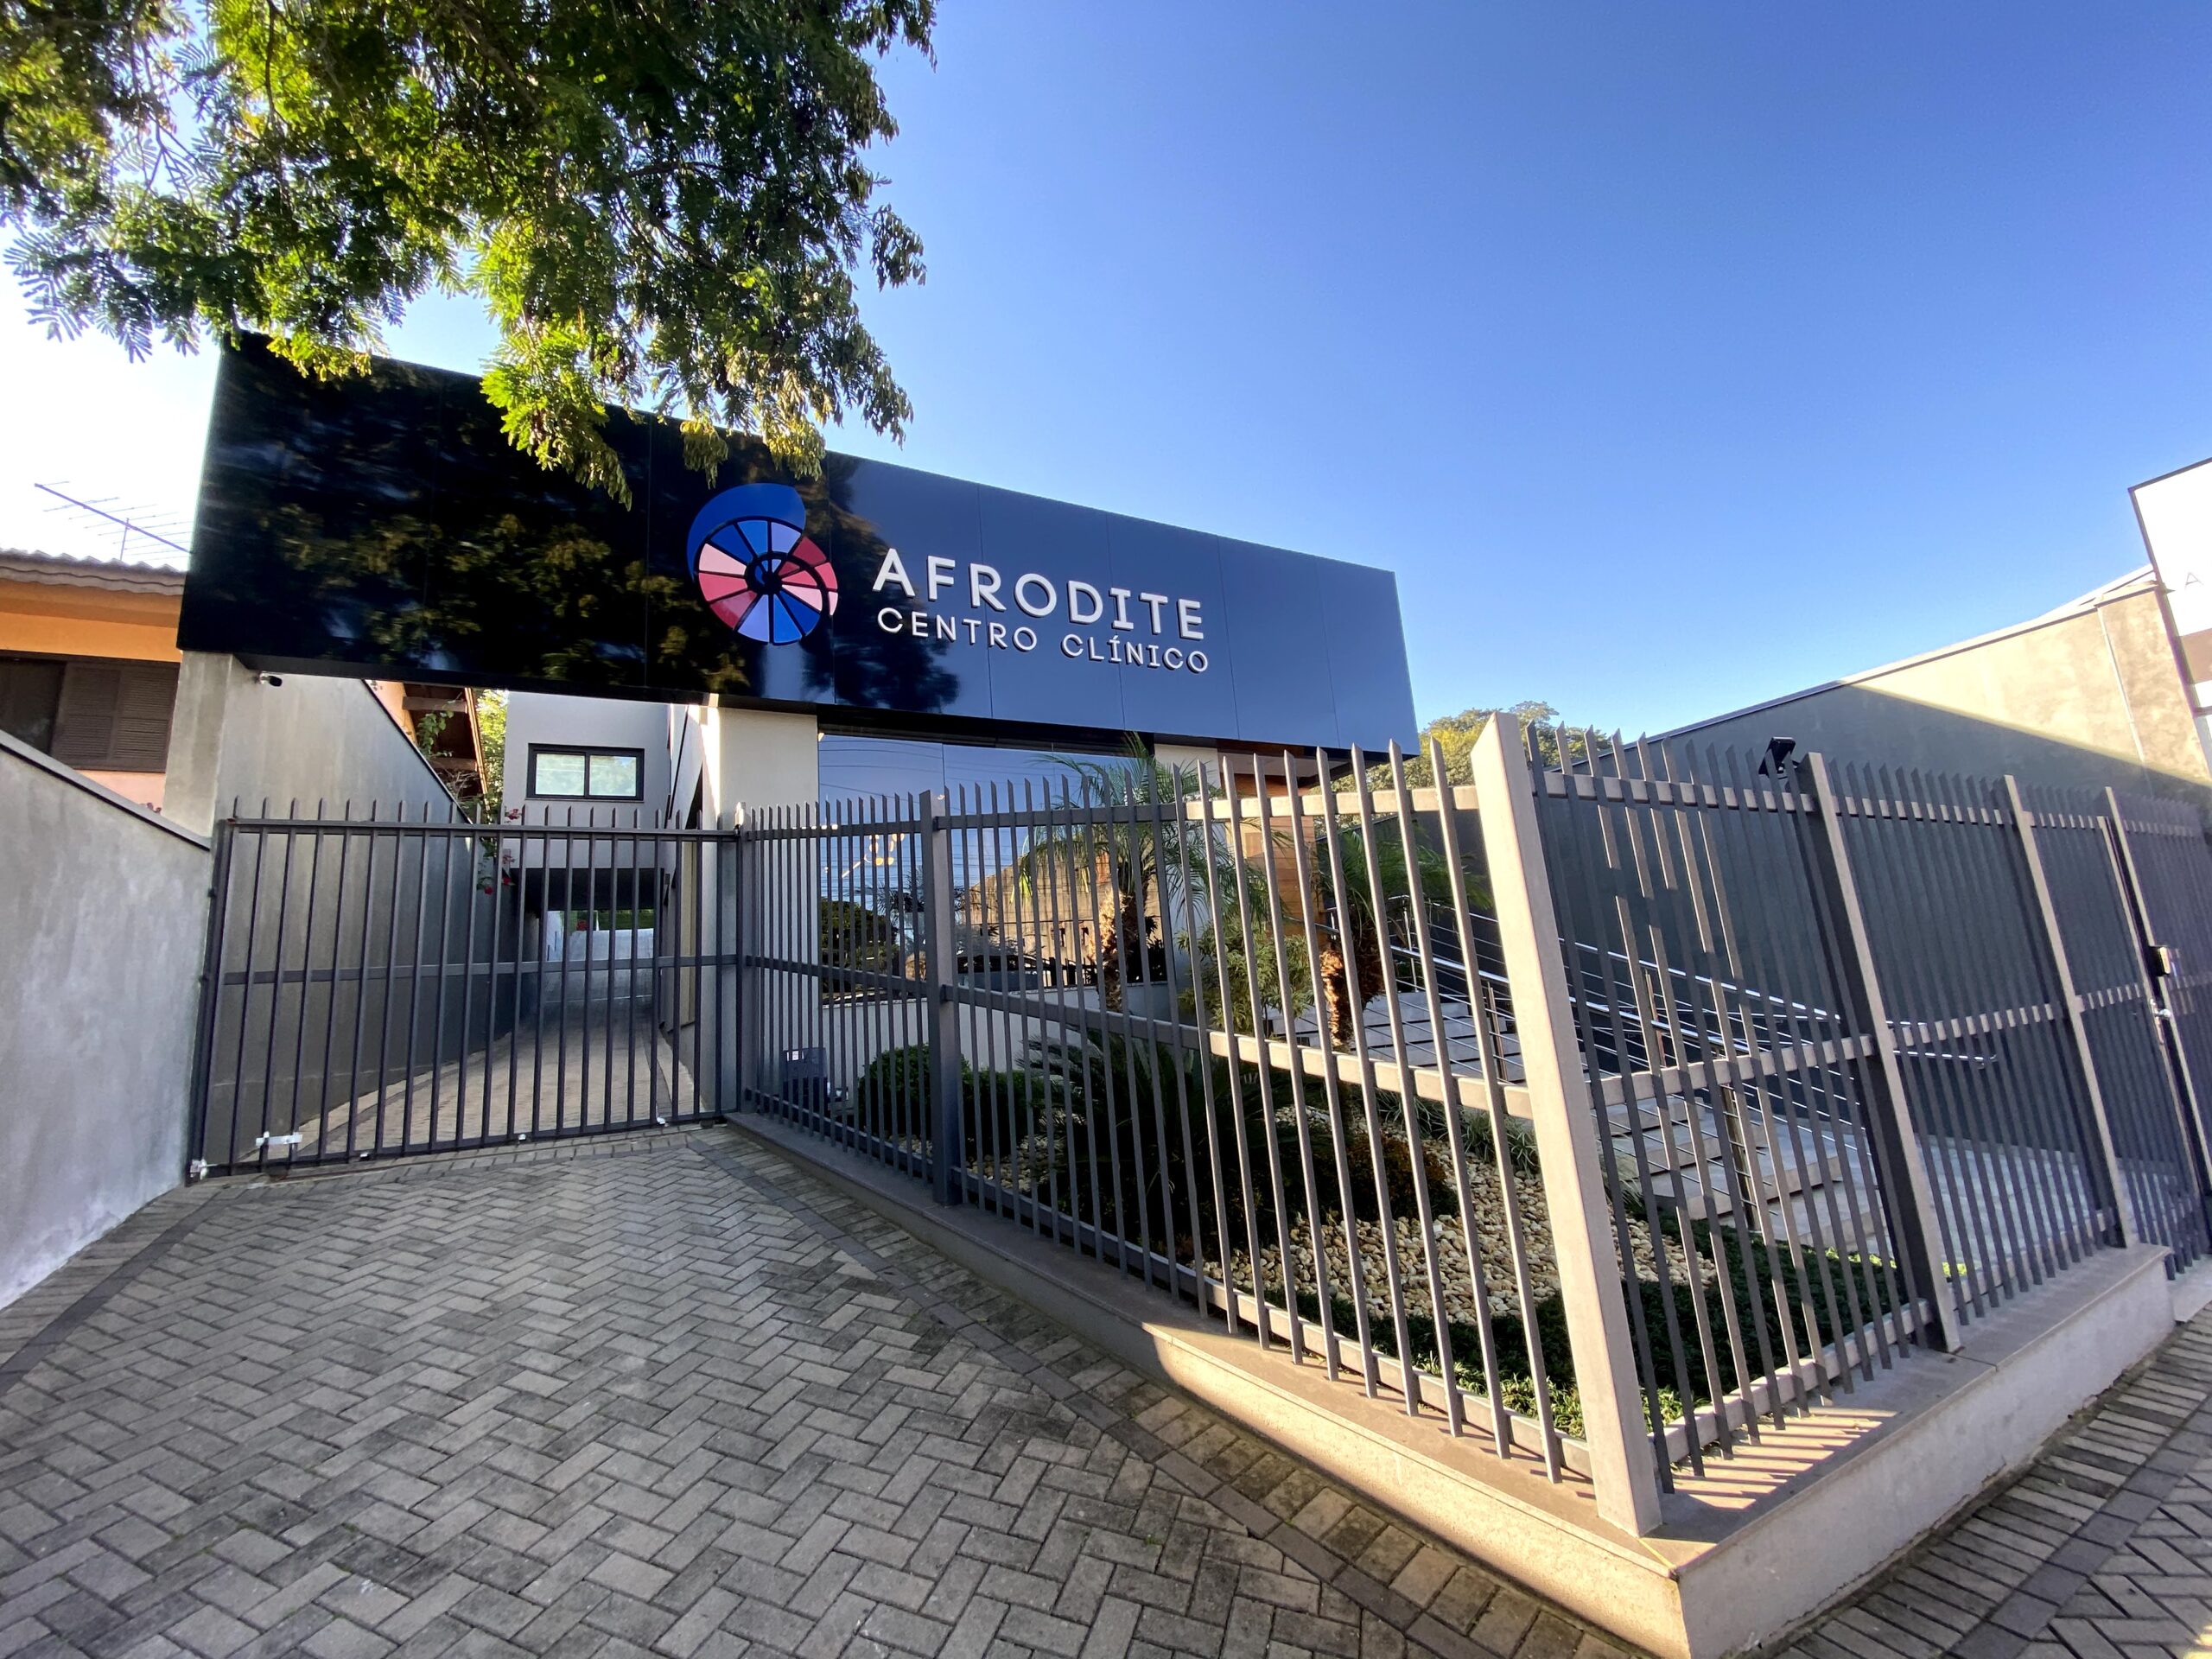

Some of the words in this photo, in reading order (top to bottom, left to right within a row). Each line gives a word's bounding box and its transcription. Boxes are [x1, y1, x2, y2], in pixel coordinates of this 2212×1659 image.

[872, 548, 1205, 640] AFRODITE
[877, 607, 1038, 652] CENTRO
[1061, 633, 1209, 674] CLÍNICO
